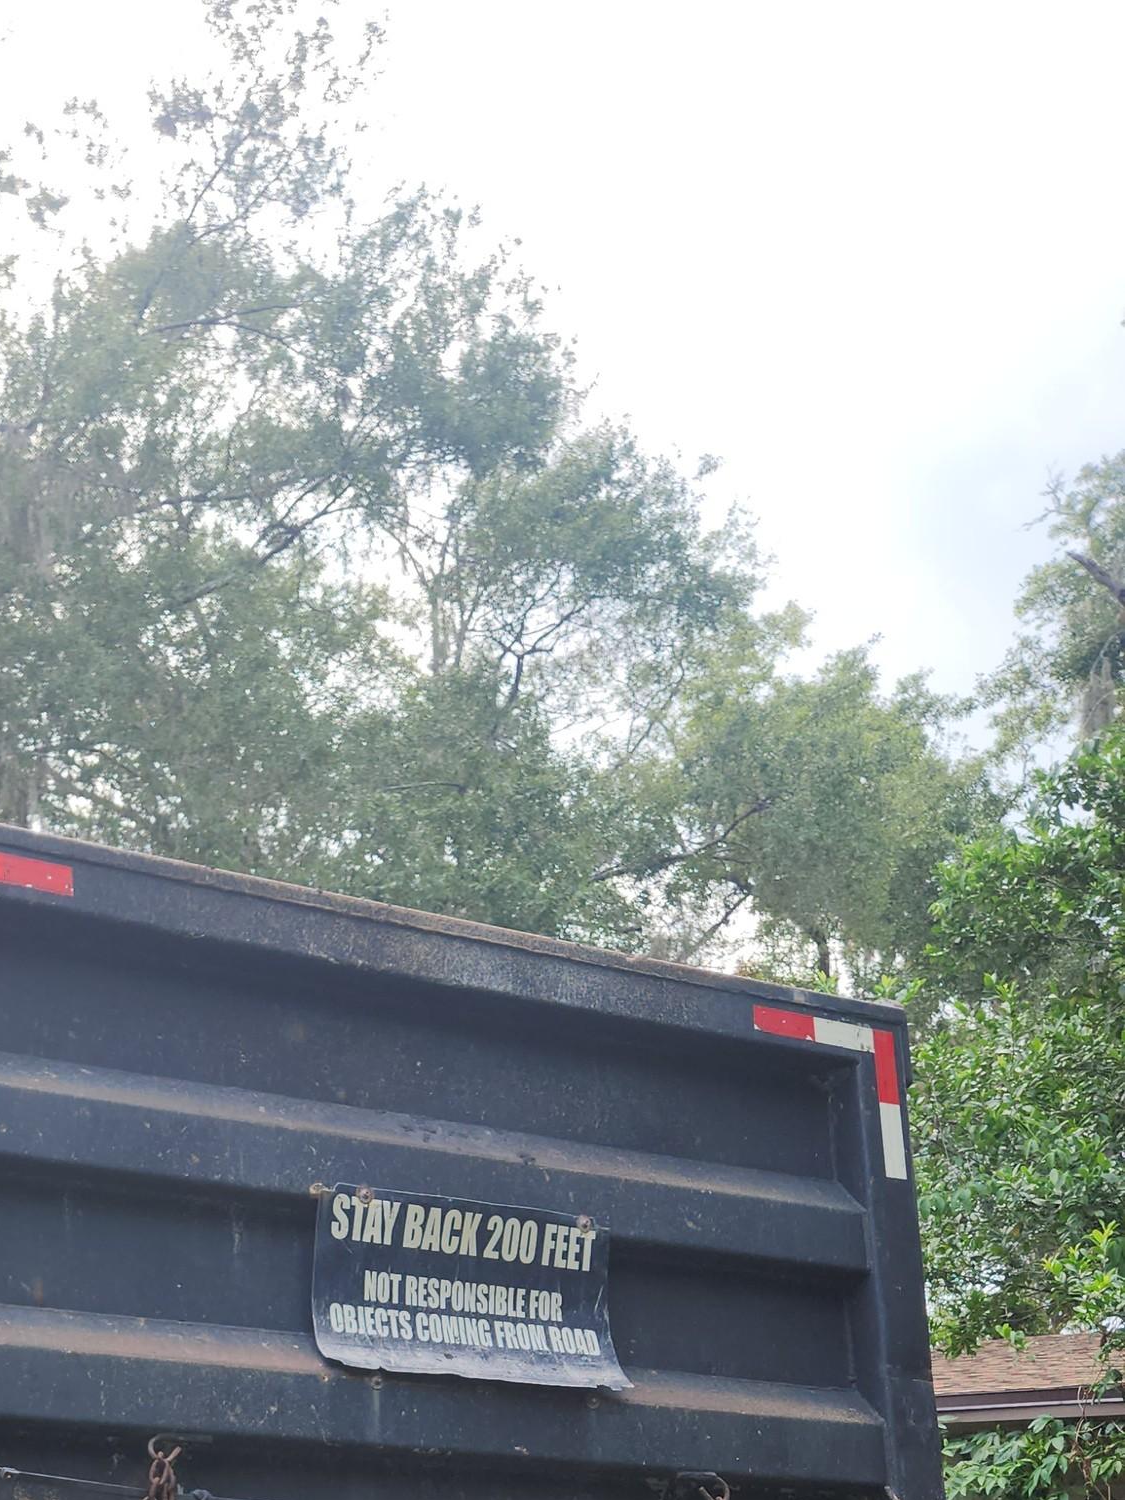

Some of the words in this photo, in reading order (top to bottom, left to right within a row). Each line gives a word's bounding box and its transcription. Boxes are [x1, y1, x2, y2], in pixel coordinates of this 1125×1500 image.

[331, 1194, 401, 1245] STAY
[403, 1204, 482, 1256] BACK
[484, 1216, 537, 1264] 200
[542, 1223, 596, 1272] FEET
[364, 1271, 402, 1304] NOT
[406, 1276, 526, 1318] RESPONSIBLE
[530, 1291, 562, 1322] FOR
[330, 1304, 413, 1340] OBJECTS
[416, 1314, 493, 1348] COMING
[495, 1321, 549, 1352] FROM
[553, 1327, 601, 1356] ROAD
